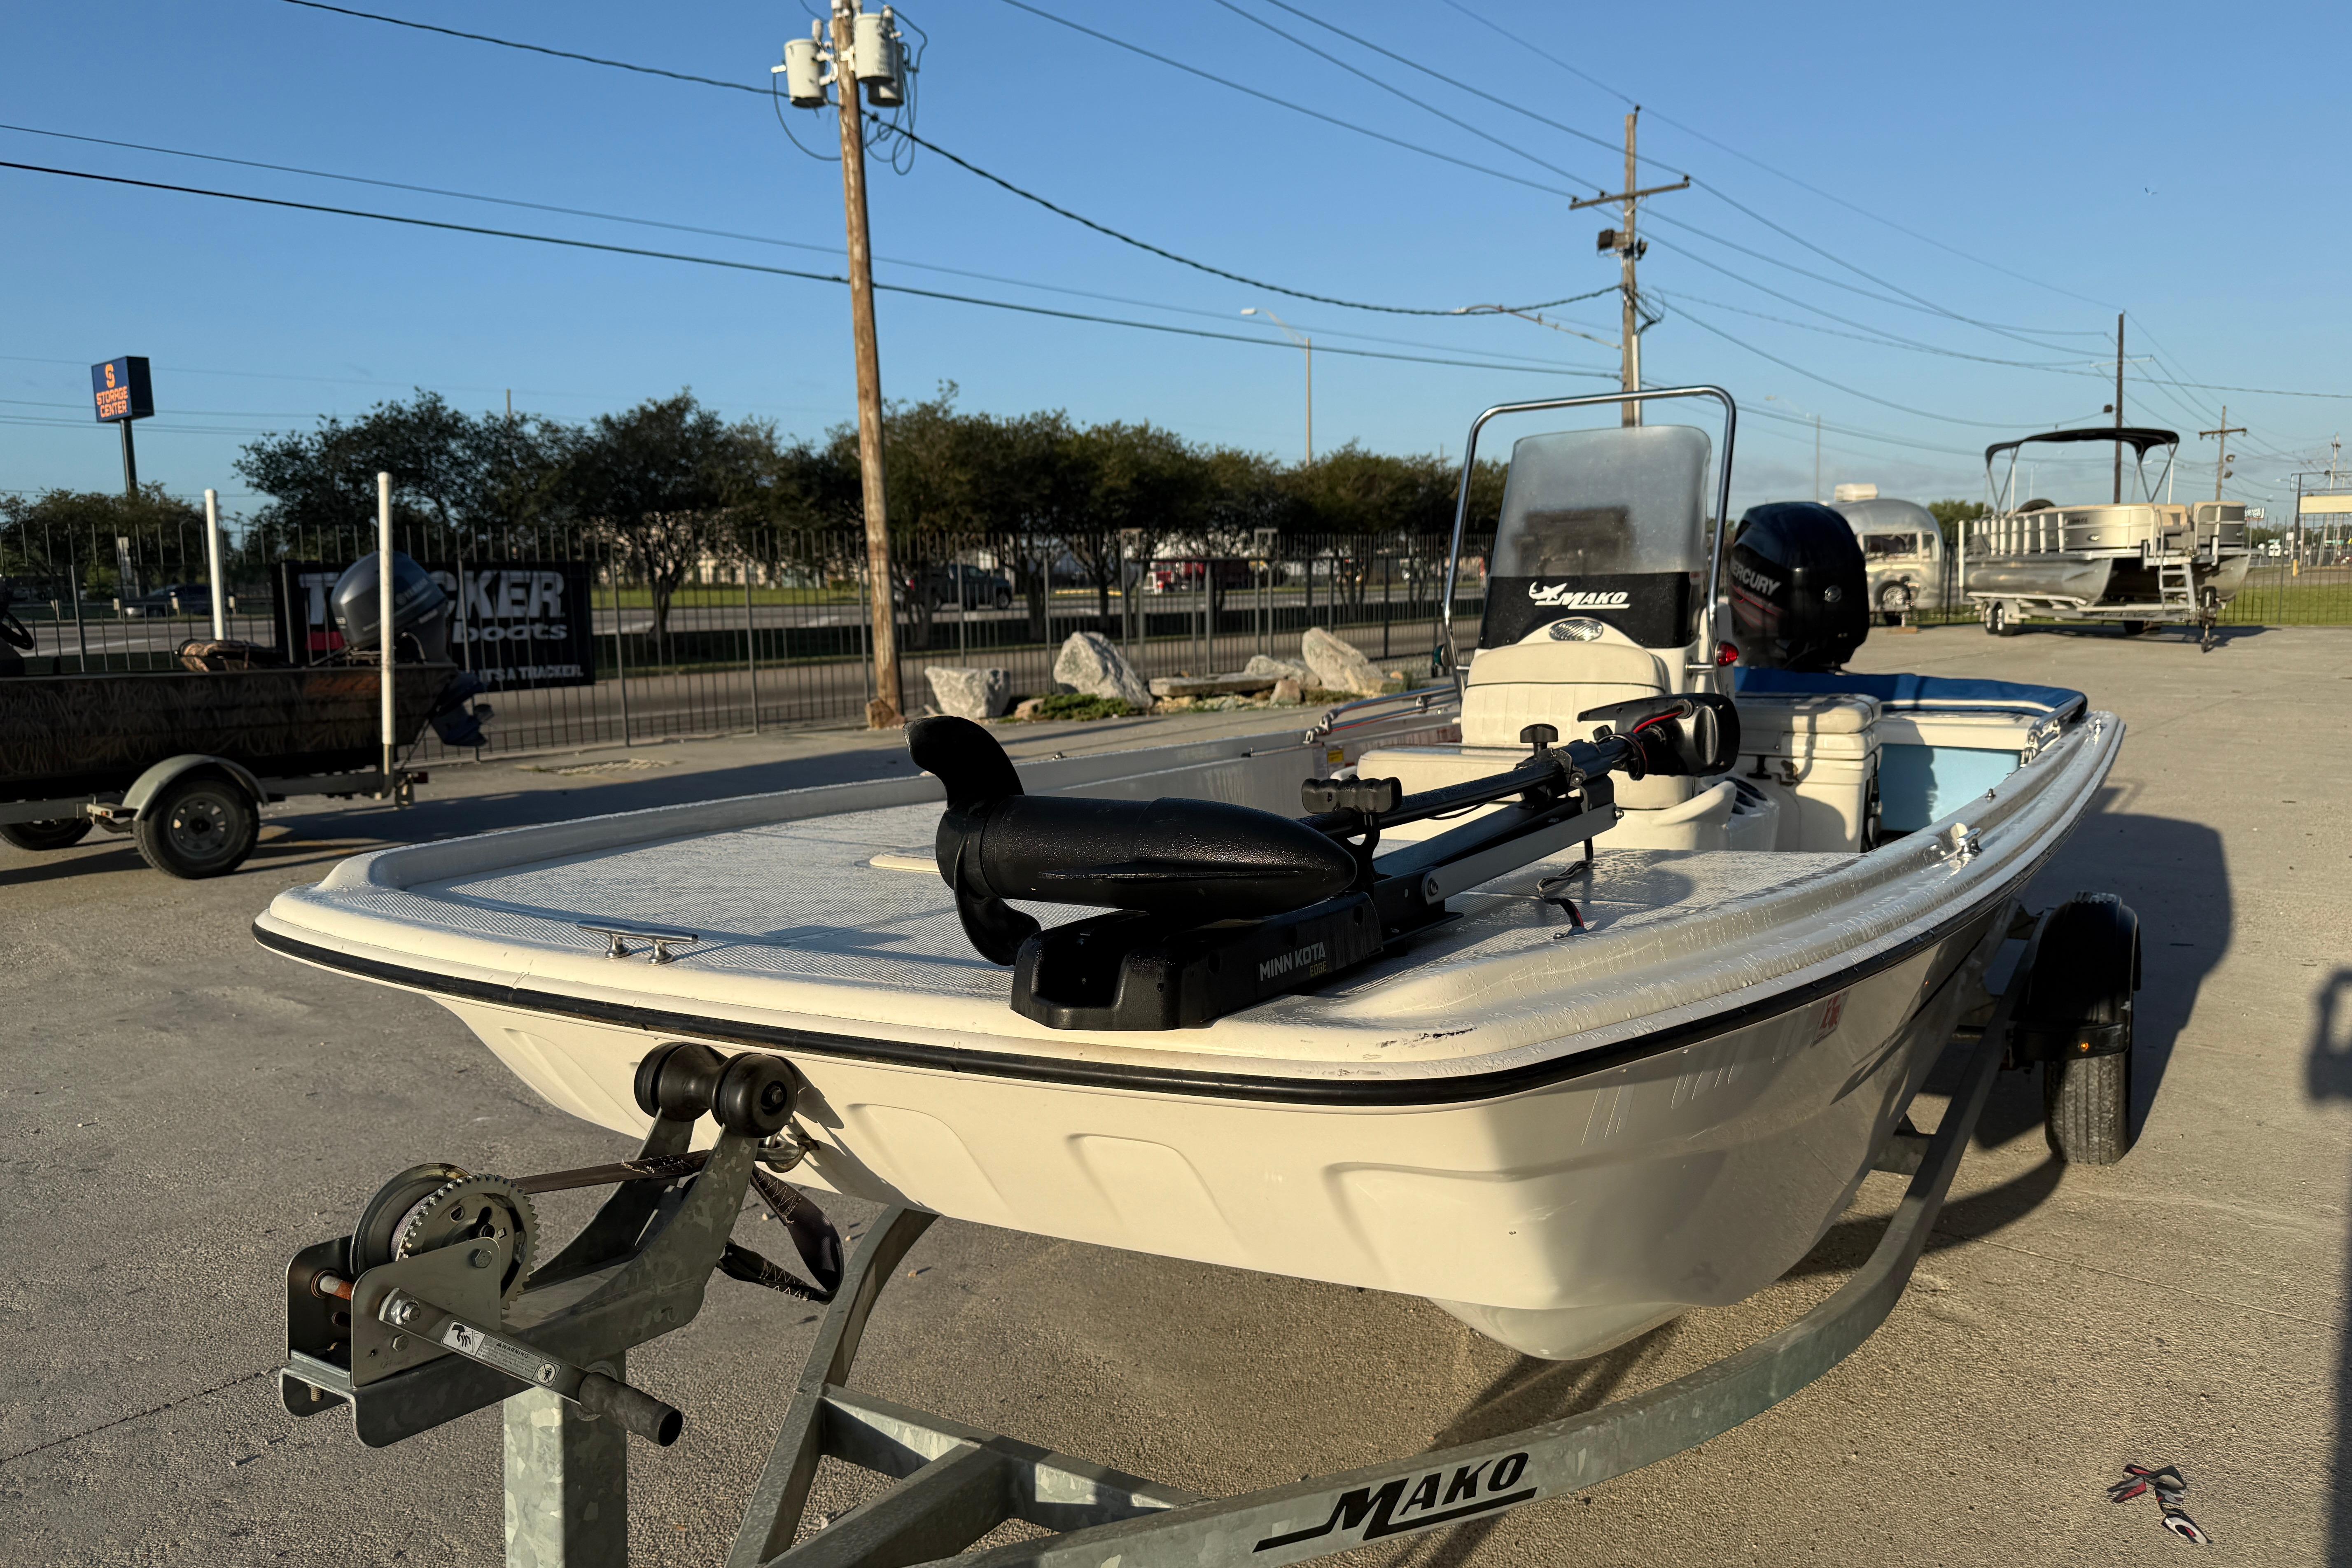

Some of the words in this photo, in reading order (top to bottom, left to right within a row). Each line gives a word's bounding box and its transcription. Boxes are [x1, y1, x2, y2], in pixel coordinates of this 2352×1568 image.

[96, 386, 128, 406] STORAGE
[100, 400, 128, 418] CENTER
[1730, 557, 1782, 596] ERCURY
[298, 569, 565, 625] TCKER
[1535, 592, 1631, 609] MAKO
[453, 621, 567, 644] boats
[507, 667, 516, 681] A
[1259, 952, 1293, 981] MINN
[1295, 941, 1326, 968] KOTA
[1310, 961, 1327, 978] EDGE
[501, 1343, 529, 1358] WARNING
[1252, 1452, 1537, 1553] MAKO
